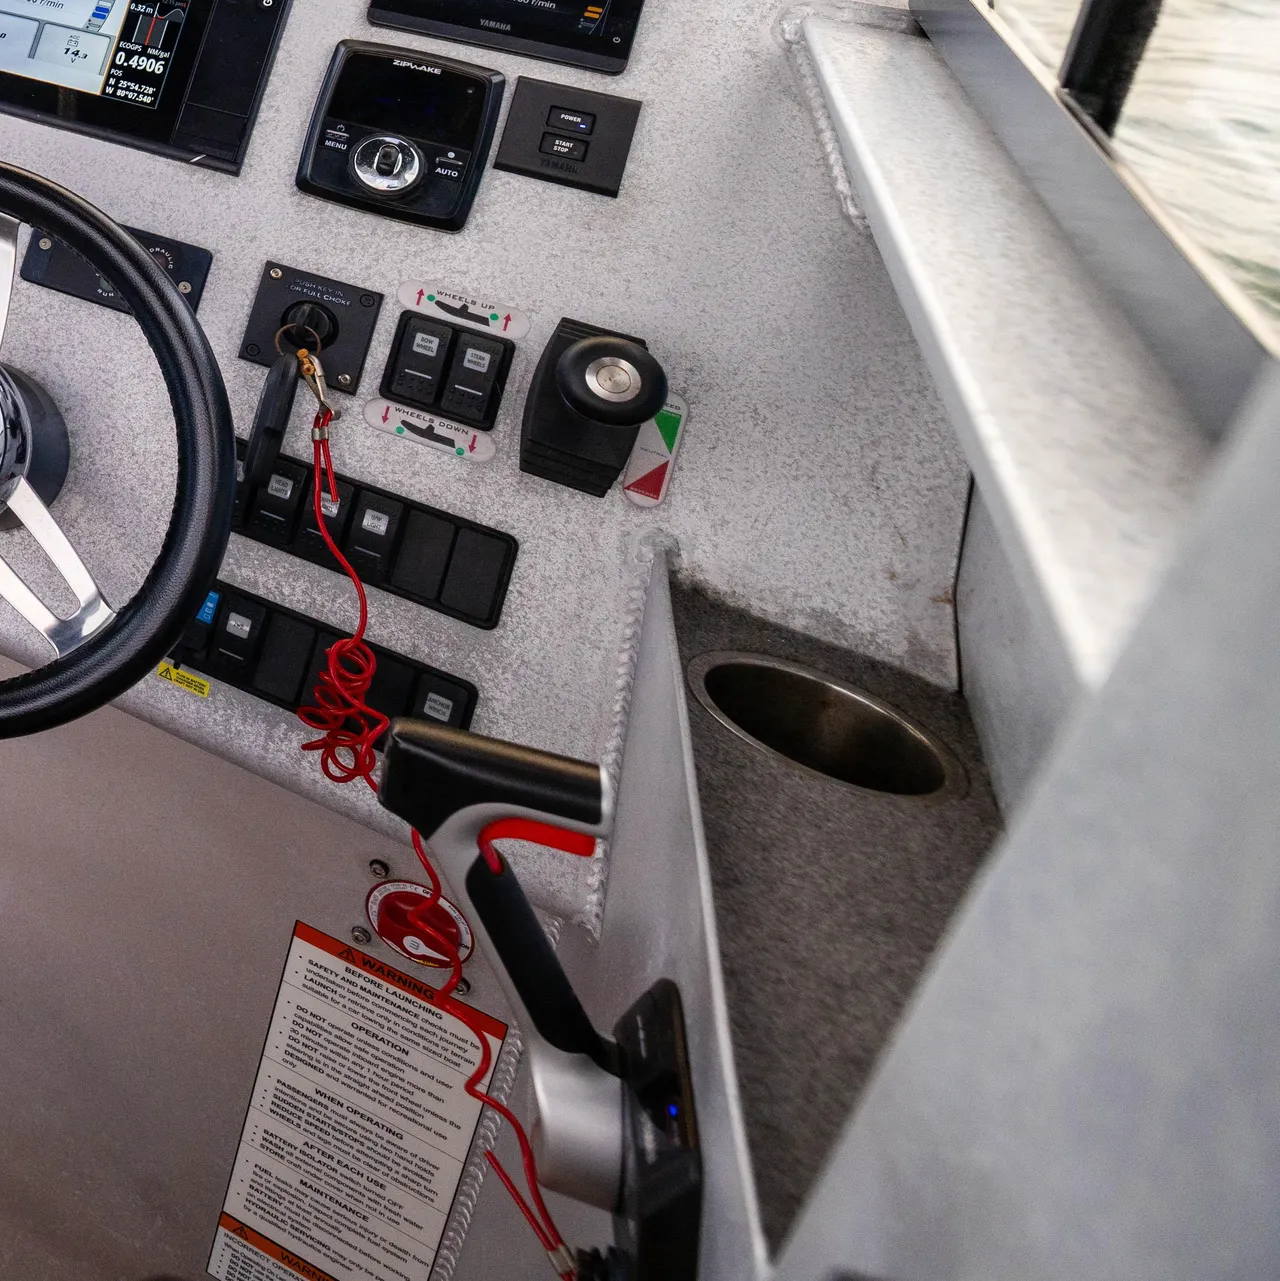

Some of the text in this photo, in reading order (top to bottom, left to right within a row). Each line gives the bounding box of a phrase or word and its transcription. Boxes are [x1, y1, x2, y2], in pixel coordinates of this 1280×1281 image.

[130, 3, 146, 12] 0.32
[531, 0, 556, 9] r/min
[479, 19, 511, 32] YAMAHA
[119, 41, 170, 58] ECOGPS NM/gal
[115, 52, 165, 74] 0.4906
[393, 59, 441, 75] ZIPWAKE
[106, 86, 114, 94] W
[560, 114, 582, 123] POWER
[324, 140, 347, 151] MENU
[553, 145, 569, 153] STOP
[555, 140, 574, 148] START
[435, 167, 458, 178] AUTO
[303, 288, 321, 298] FULL
[323, 294, 351, 306] CHOKE
[437, 290, 495, 310] WHEELS UP
[416, 343, 434, 352] WHEEL
[467, 359, 486, 369] WHEELS
[394, 406, 469, 435] WHEELS DOWN
[366, 520, 383, 530] LIGHT
[428, 697, 451, 710] ANCHOR
[360, 955, 436, 1000] WARNING
[344, 965, 443, 1020] BEFORE LAUNCHING
[305, 965, 469, 1055] undertaken before commencing each journey
[307, 958, 480, 1051] SAFETY AND MAINTENANCE checks must be
[349, 1020, 410, 1057] OPERATION
[314, 1087, 403, 1141] WHEN OPERATING
[302, 1139, 387, 1191] AFTER EACH USE
[298, 1177, 370, 1223] MAINTENANCE
